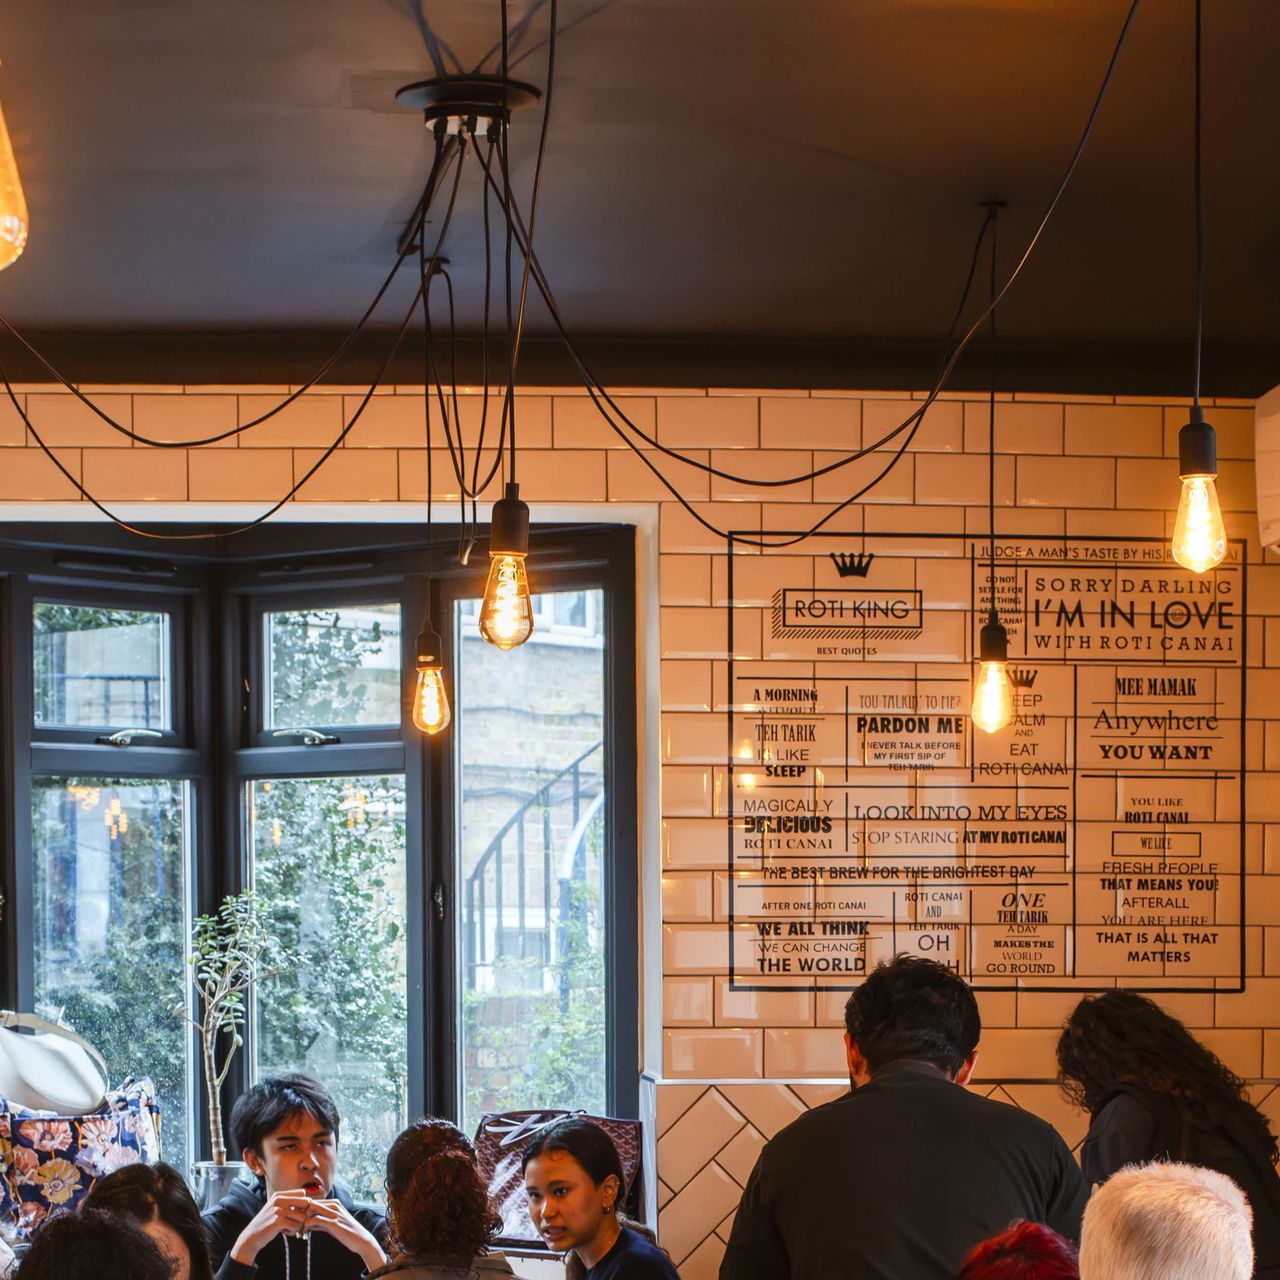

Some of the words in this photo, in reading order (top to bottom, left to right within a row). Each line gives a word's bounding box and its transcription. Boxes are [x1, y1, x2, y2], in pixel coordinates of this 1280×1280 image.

[980, 545, 1022, 558] JUDGE
[1025, 547, 1035, 558] A
[1038, 547, 1079, 558] MAN'S
[1083, 547, 1120, 559] TASTE
[1123, 548, 1138, 559] BY
[1143, 549, 1162, 560] HIS
[978, 586, 1005, 594] SETLE
[1035, 577, 1112, 592] SORRY
[1121, 579, 1232, 594] DARLING
[795, 600, 843, 618] ROTI
[853, 600, 910, 619] KING
[1034, 598, 1086, 628] I'M
[1100, 600, 1135, 629] IN
[1150, 601, 1234, 630] LOVE
[1007, 628, 1018, 636] EH
[1034, 635, 1091, 649] WITH
[1100, 636, 1152, 650] ROTI
[1160, 637, 1233, 651] CANAI
[817, 647, 838, 655] BEST
[841, 647, 877, 655] QUOTES
[1117, 677, 1143, 696] MEE
[1147, 678, 1197, 696] MAMAK
[753, 688, 761, 701] A
[765, 688, 818, 702] MORNING
[859, 694, 879, 709] YOU
[925, 695, 938, 709] TO
[941, 695, 961, 709] ME?
[1012, 694, 1043, 707] EEP
[857, 717, 930, 733] PARDON
[937, 717, 963, 734] ME
[1093, 709, 1219, 736] Anywhere
[755, 724, 778, 741] TEH
[781, 724, 816, 742] TARIK
[1015, 729, 1034, 737] AND
[899, 742, 922, 750] TALK
[924, 742, 961, 750] BEFORE
[1010, 743, 1039, 756] EAT
[1099, 744, 1144, 760] YOU
[1147, 745, 1213, 760] WANT
[776, 749, 810, 761] LIKE
[874, 752, 887, 760] MY
[889, 752, 915, 760] FIRST
[917, 752, 932, 760] SIP
[934, 752, 946, 760] OF
[766, 765, 806, 777] SLEEP
[979, 762, 1016, 776] ROTI
[1021, 762, 1068, 776] CANAI
[744, 799, 833, 812] MAGICALLY
[1131, 797, 1154, 806] YOU
[1158, 798, 1183, 806] LIKE
[854, 805, 915, 820] LOOK
[920, 805, 971, 820] INTO
[978, 805, 1011, 820] MY
[1017, 805, 1068, 820] EYES
[1124, 811, 1153, 823] ROTI
[1156, 811, 1189, 824] CANAI
[744, 816, 832, 833] DELICIOUS
[744, 838, 781, 849] ROTI
[786, 838, 833, 849] CANAI
[852, 831, 890, 844] STOP
[894, 831, 959, 844] STARING
[963, 831, 978, 843] AT
[979, 831, 1000, 843] MY
[1001, 831, 1030, 843] ROTI
[1031, 830, 1066, 843] CANAI
[1140, 837, 1153, 849] WE
[762, 866, 787, 879] THE
[791, 866, 826, 879] BEST
[829, 866, 868, 879] BREW
[872, 866, 899, 879] FOR
[904, 866, 929, 878] THE
[933, 866, 1006, 878] BRIGHTEST
[1010, 866, 1036, 878] DAY
[1102, 862, 1153, 874] FRESH
[1100, 878, 1132, 890] THAT
[1137, 878, 1183, 891] MEANS
[904, 892, 928, 901] ROTI
[931, 892, 963, 901] CANAI
[1001, 892, 1046, 908] ONE
[1121, 897, 1190, 908] AFTERALL
[761, 902, 790, 910] AFTER
[793, 902, 812, 910] ONE
[815, 902, 836, 910] ROTI
[838, 902, 866, 910] CANAI
[926, 905, 942, 918] AND
[997, 910, 1018, 923] TEH
[1018, 910, 1048, 923] TARIK
[1102, 915, 1133, 926] YOU
[1137, 915, 1164, 926] ARE
[1170, 915, 1209, 926] HERE
[756, 921, 782, 936] WE
[787, 921, 815, 936] ALL
[820, 920, 870, 936] THINK
[908, 922, 927, 931] TEH
[931, 922, 960, 931] TARIK
[1007, 925, 1015, 933] A
[1017, 925, 1038, 934] DAY
[918, 934, 950, 951] OH
[993, 940, 1031, 948] MAKES
[1032, 940, 1055, 948] THE
[1096, 932, 1132, 943] THAT
[1136, 932, 1148, 944] IS
[1153, 932, 1178, 944] ALL
[1182, 933, 1219, 944] THAT
[758, 943, 779, 952] WE
[782, 943, 809, 953] CAN
[813, 942, 866, 952] CHANGE
[1002, 951, 1043, 961] WORLD
[1127, 951, 1191, 962] MATTERS
[756, 958, 792, 972] THE
[798, 957, 866, 972] WORLD
[986, 963, 1007, 973] GO
[1010, 963, 1056, 974] ROUND
